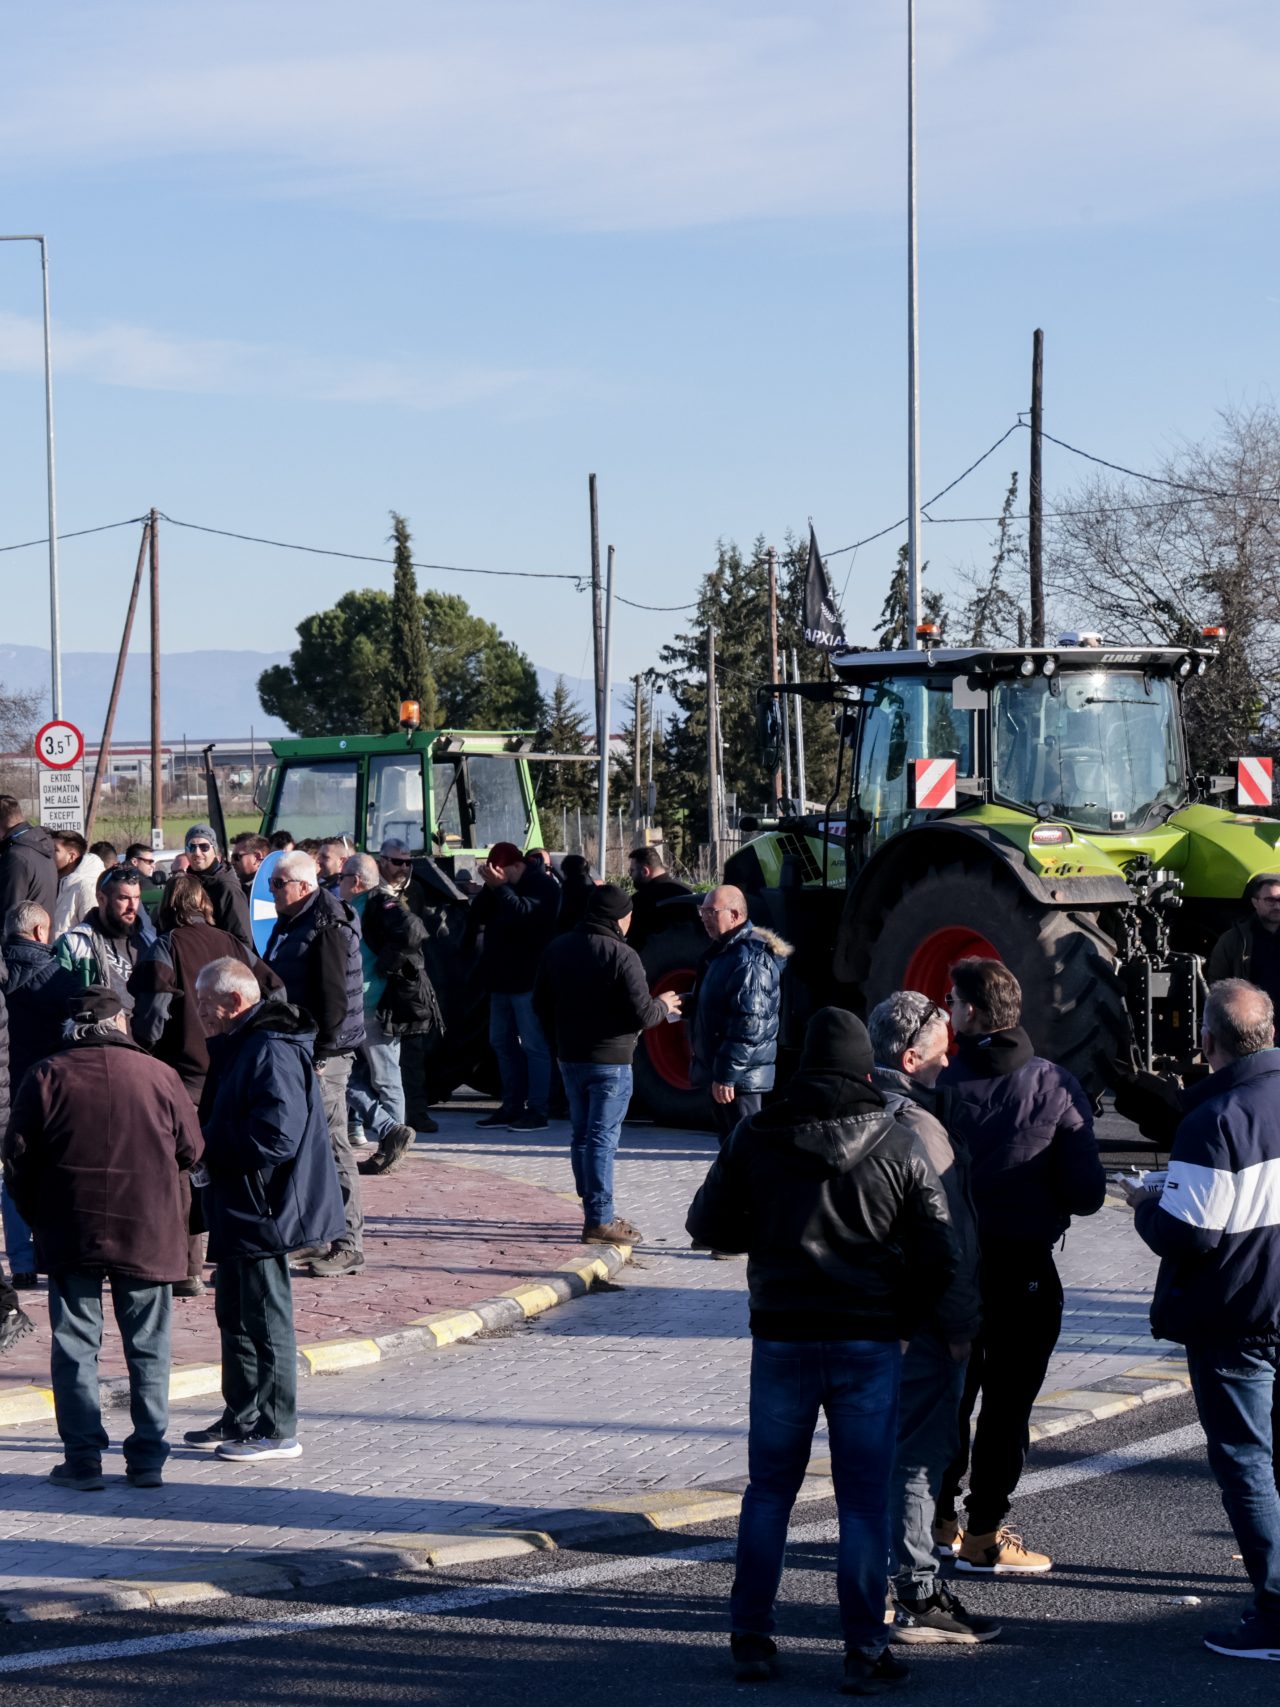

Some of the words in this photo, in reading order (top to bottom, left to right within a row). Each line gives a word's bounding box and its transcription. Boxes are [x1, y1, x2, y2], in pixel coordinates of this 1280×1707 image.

[1100, 654, 1143, 663] CLAAS
[50, 774, 71, 783] ΕΚΤΟΣ
[45, 796, 55, 804] ΜΕ
[57, 795, 79, 804] ΑΔΕΙΑ
[49, 811, 74, 820] EXCEPT
